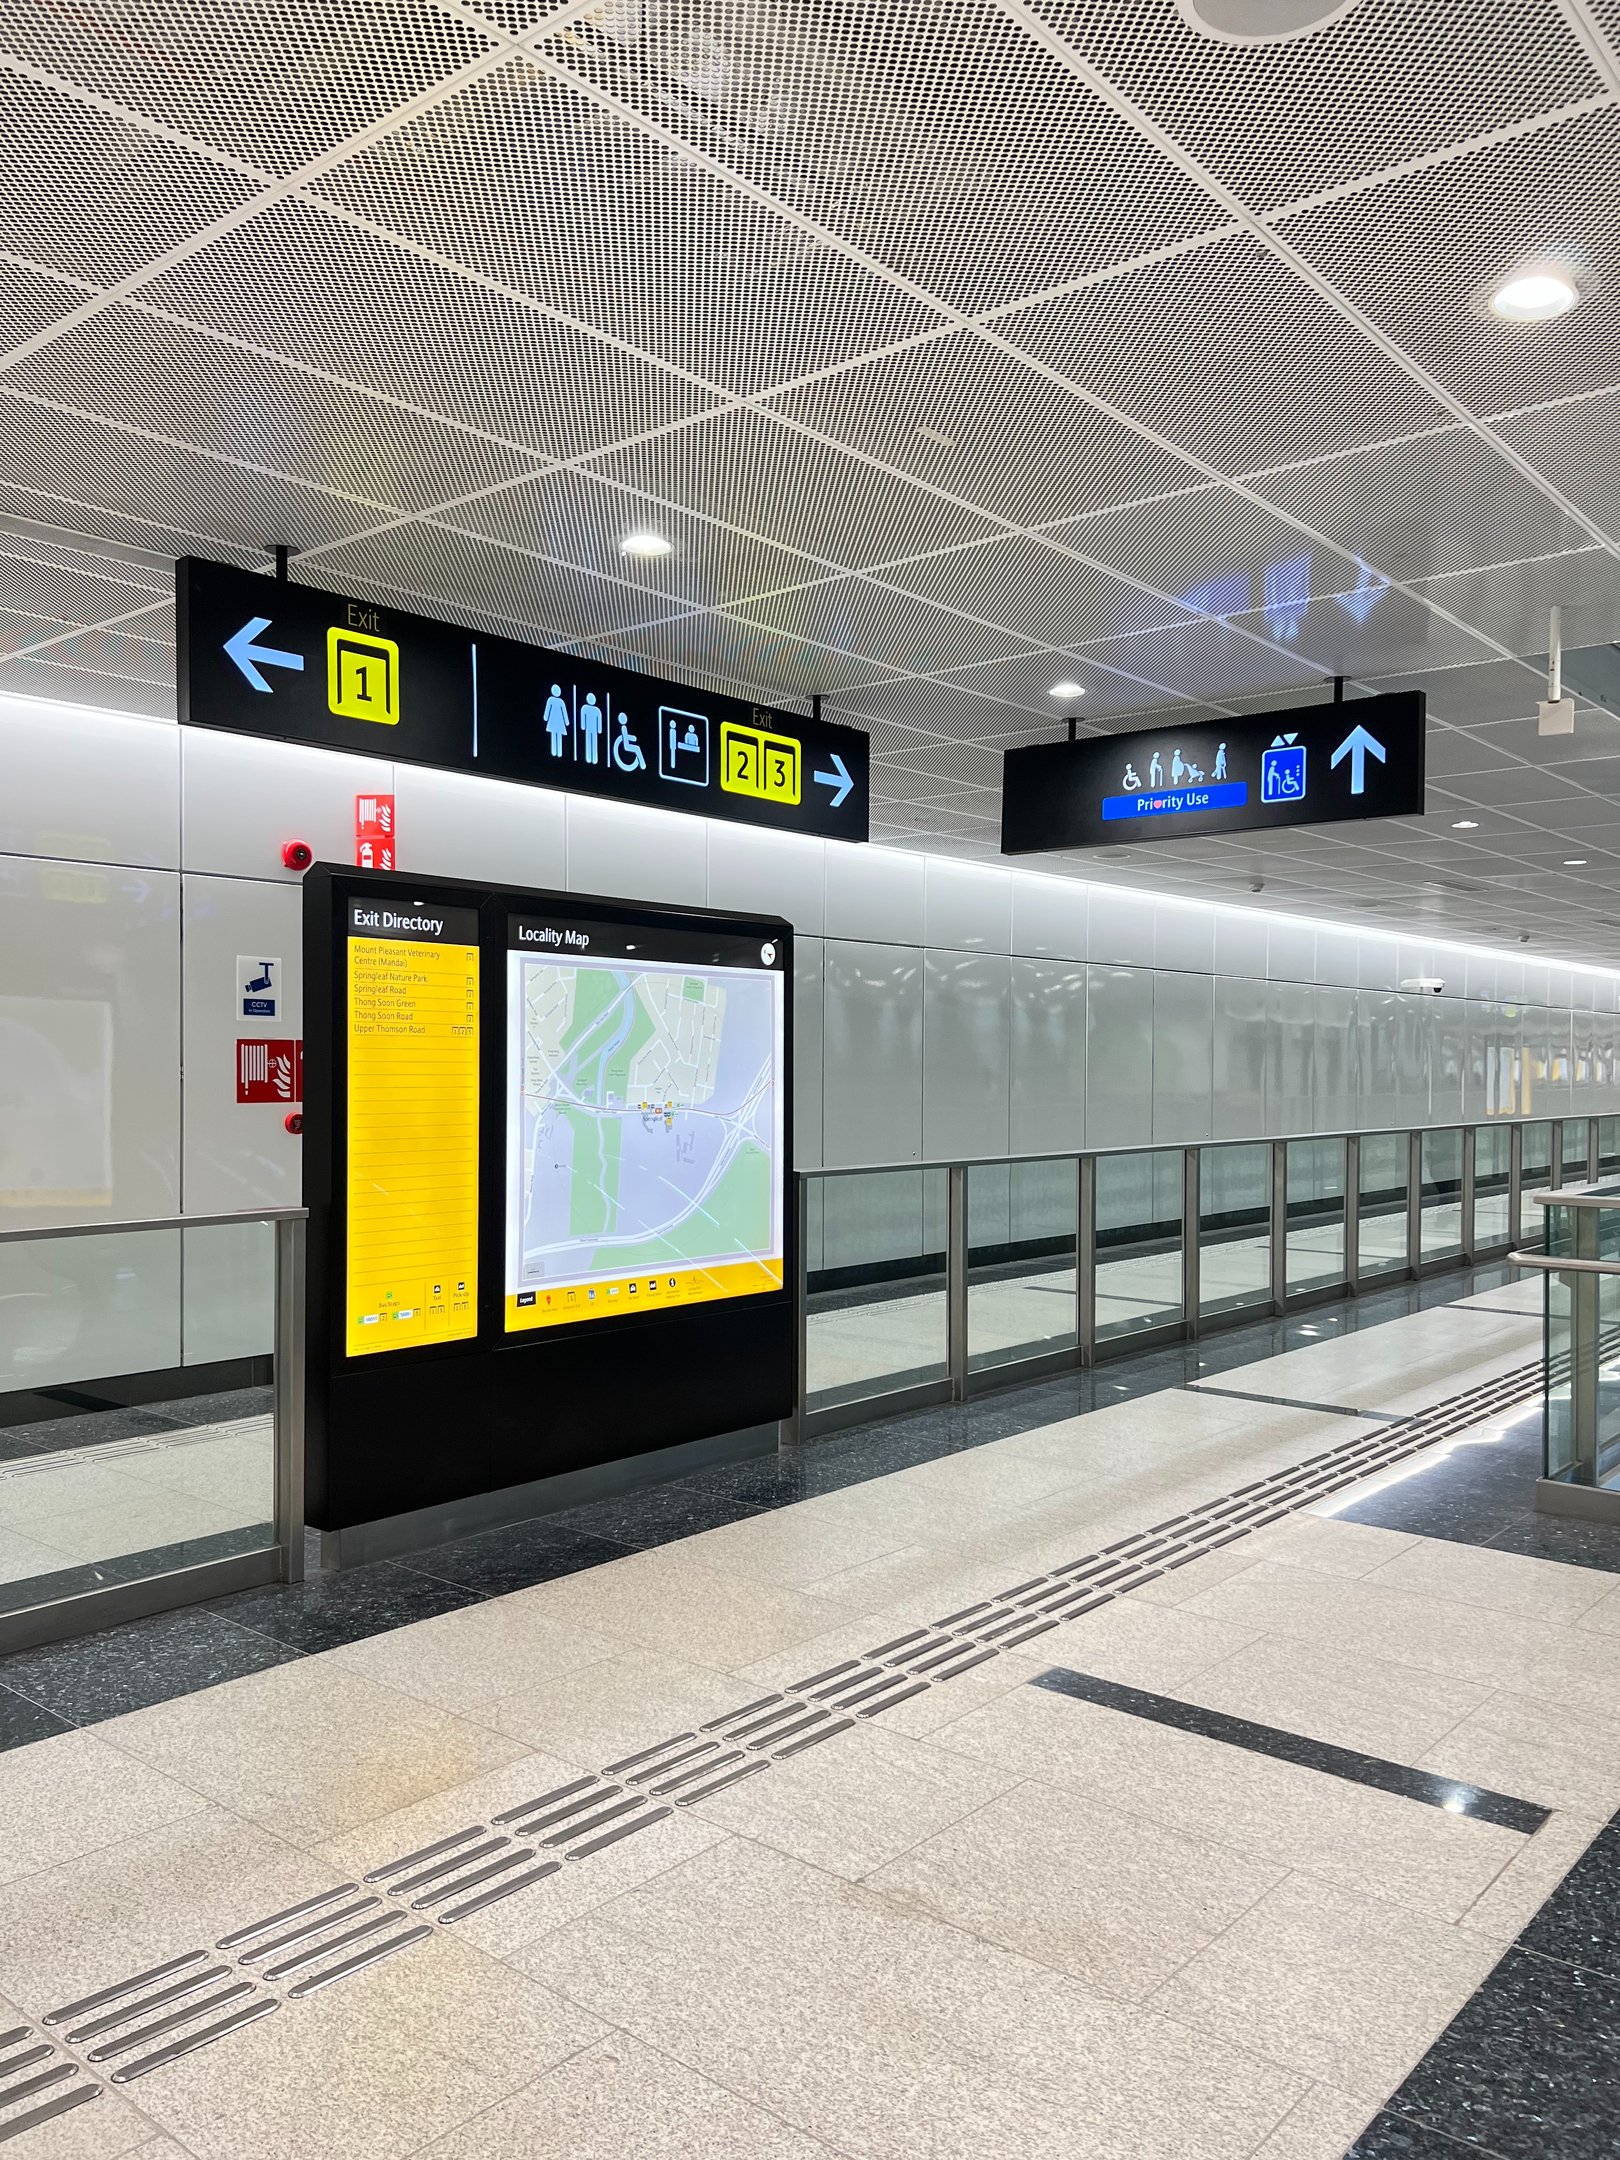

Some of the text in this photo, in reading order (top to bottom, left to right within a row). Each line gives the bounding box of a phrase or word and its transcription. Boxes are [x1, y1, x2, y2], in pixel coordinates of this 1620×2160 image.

[347, 603, 380, 632] Exit
[355, 666, 372, 702] 1
[752, 707, 773, 729] Exit
[737, 751, 786, 787] 2 3
[1186, 792, 1209, 806] Use
[354, 909, 443, 936] Exit Directory
[518, 925, 590, 949] Locality Map
[354, 945, 440, 960] Mount Pleasant Veterinary
[354, 956, 407, 968] Centre (Mandai)
[354, 970, 428, 982] Springleaf Nature Park
[354, 984, 407, 994] Springleaf Road
[354, 997, 416, 1008] Thong Soon Green
[354, 1011, 413, 1021] Thong Soon Road
[354, 1024, 426, 1034] Upper Thomson Road
